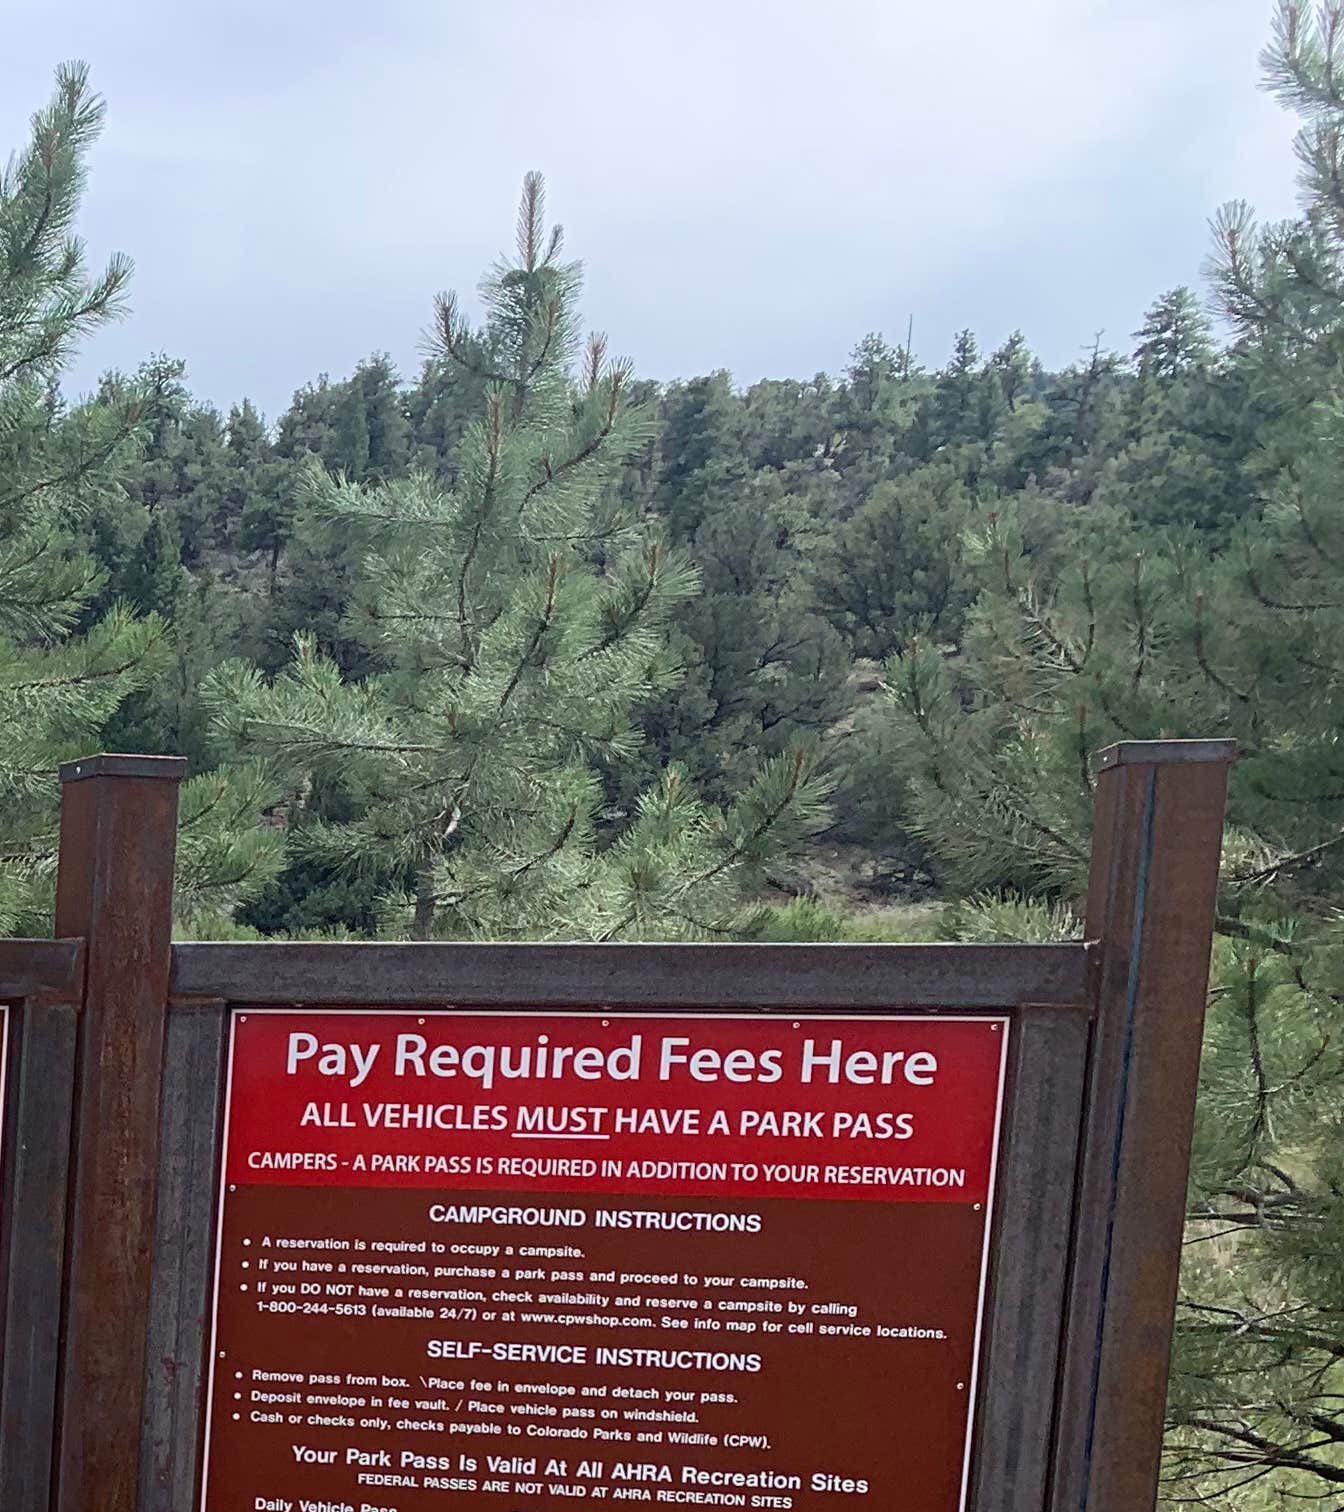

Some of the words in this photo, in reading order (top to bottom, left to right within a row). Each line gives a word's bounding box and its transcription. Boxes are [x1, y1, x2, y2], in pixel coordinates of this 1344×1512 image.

[287, 1033, 380, 1087] Pay
[395, 1034, 642, 1089] Required
[659, 1037, 782, 1082] Fees
[801, 1039, 937, 1085] Here
[300, 1102, 356, 1127] ALL
[363, 1103, 508, 1130] VEHICLES
[516, 1106, 608, 1132] MUST
[615, 1108, 700, 1134] HAVE
[707, 1110, 730, 1135] A
[740, 1111, 825, 1137] PARK
[833, 1112, 913, 1139] PASS
[248, 1152, 337, 1170] CAMPERS
[352, 1154, 366, 1171] A
[371, 1154, 420, 1172] PARK
[425, 1156, 471, 1173] PASS
[476, 1157, 493, 1174] IS
[498, 1157, 597, 1177] REQUIRED
[601, 1160, 622, 1177] IN
[626, 1161, 727, 1180] ADDITION
[730, 1163, 758, 1181] TO
[763, 1164, 819, 1183] YOUR
[824, 1166, 965, 1187] RESERVATION
[429, 1205, 586, 1226] CAMPGROUND
[595, 1210, 761, 1232] INSTRUCTIONS
[262, 1236, 271, 1247] A
[276, 1238, 350, 1250] reservation
[354, 1239, 366, 1250] is
[371, 1241, 426, 1253] required
[431, 1242, 445, 1253] to
[450, 1244, 500, 1256] occupy
[505, 1246, 513, 1255] a
[519, 1246, 585, 1258] campsite.
[427, 1340, 587, 1364] SELF-SERVICE
[596, 1348, 761, 1372] INSTRUCTIONS
[292, 1445, 338, 1463] Your
[346, 1448, 391, 1467] Park
[401, 1451, 450, 1470] Pass
[459, 1454, 477, 1471] Is
[487, 1456, 536, 1475] Valid
[544, 1459, 567, 1476] At
[576, 1461, 603, 1478] All
[611, 1463, 672, 1482] AHRA
[682, 1466, 801, 1489] Recreation
[811, 1473, 868, 1493] Sites
[358, 1473, 419, 1487] FEDERAL
[423, 1477, 477, 1491] PASSES
[482, 1480, 510, 1492] ARE
[515, 1482, 544, 1494] NOT
[548, 1484, 586, 1497] VALID
[591, 1486, 609, 1498] AT
[612, 1488, 651, 1500] AHRA
[657, 1490, 745, 1506] RECREATION
[751, 1495, 792, 1509] SITES
